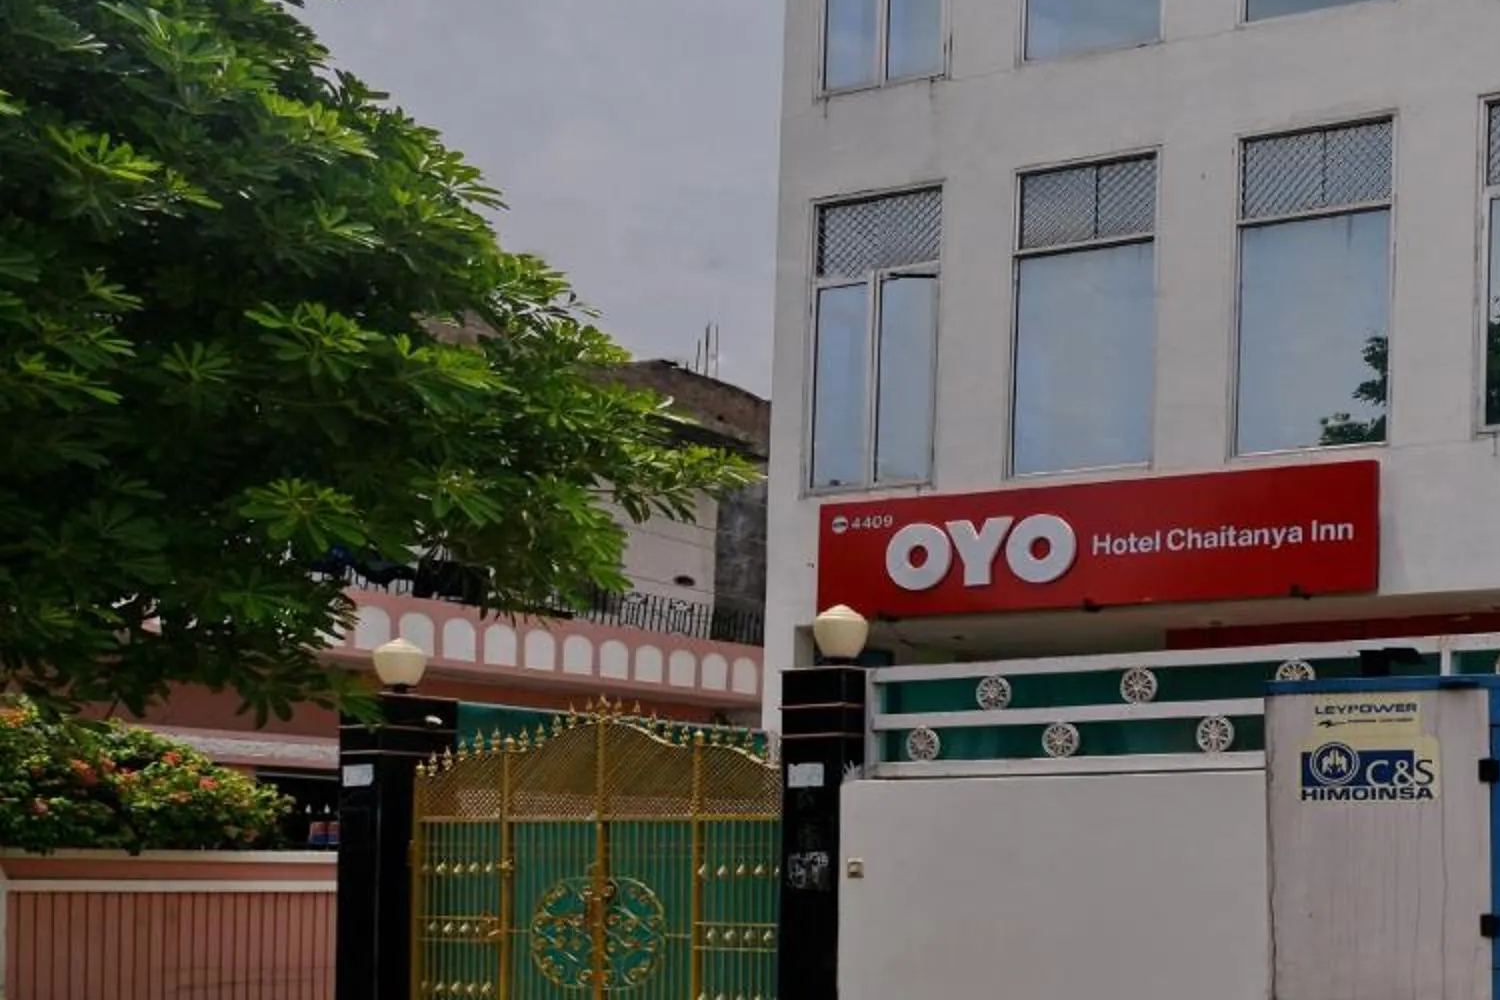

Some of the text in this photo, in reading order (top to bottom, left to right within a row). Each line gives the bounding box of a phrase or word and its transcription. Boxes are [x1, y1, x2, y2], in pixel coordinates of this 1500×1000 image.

[851, 515, 893, 530] 4409
[1092, 519, 1354, 556] Hotel Chaitanya Inn
[885, 513, 1077, 591] OYO
[1315, 703, 1417, 715] LEYPOWER
[1366, 758, 1434, 787] C&S
[1301, 786, 1434, 801] HIMOINSA
